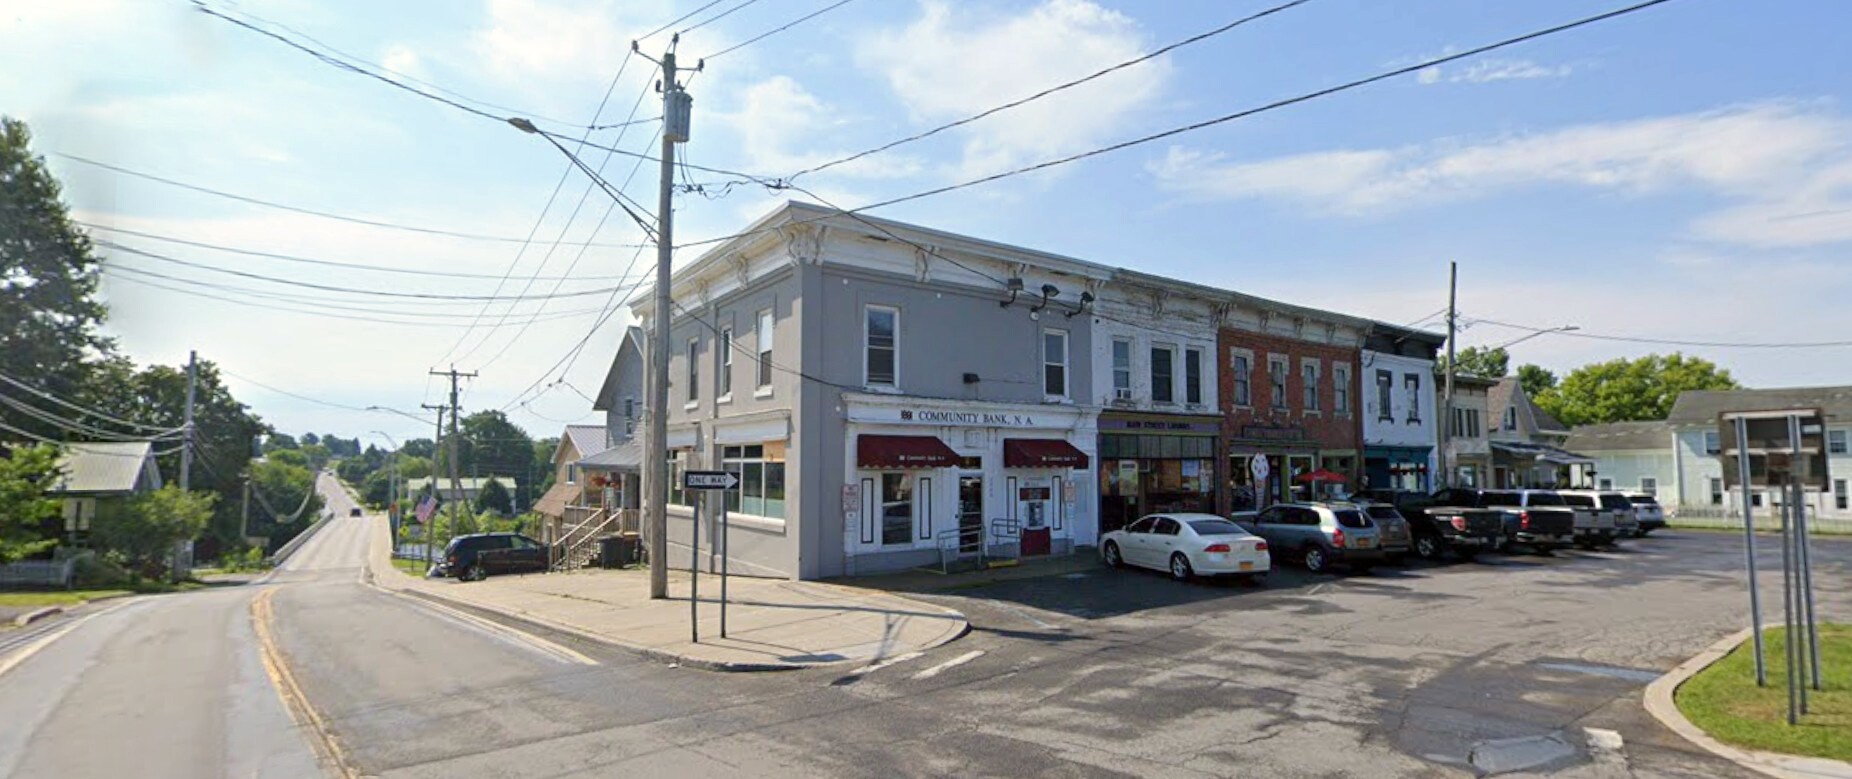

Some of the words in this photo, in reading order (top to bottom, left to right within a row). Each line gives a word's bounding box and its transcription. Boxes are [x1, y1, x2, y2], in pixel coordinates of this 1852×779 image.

[918, 410, 979, 423] COMMUNITY
[689, 475, 705, 484] ONE
[711, 475, 727, 484] WAY
